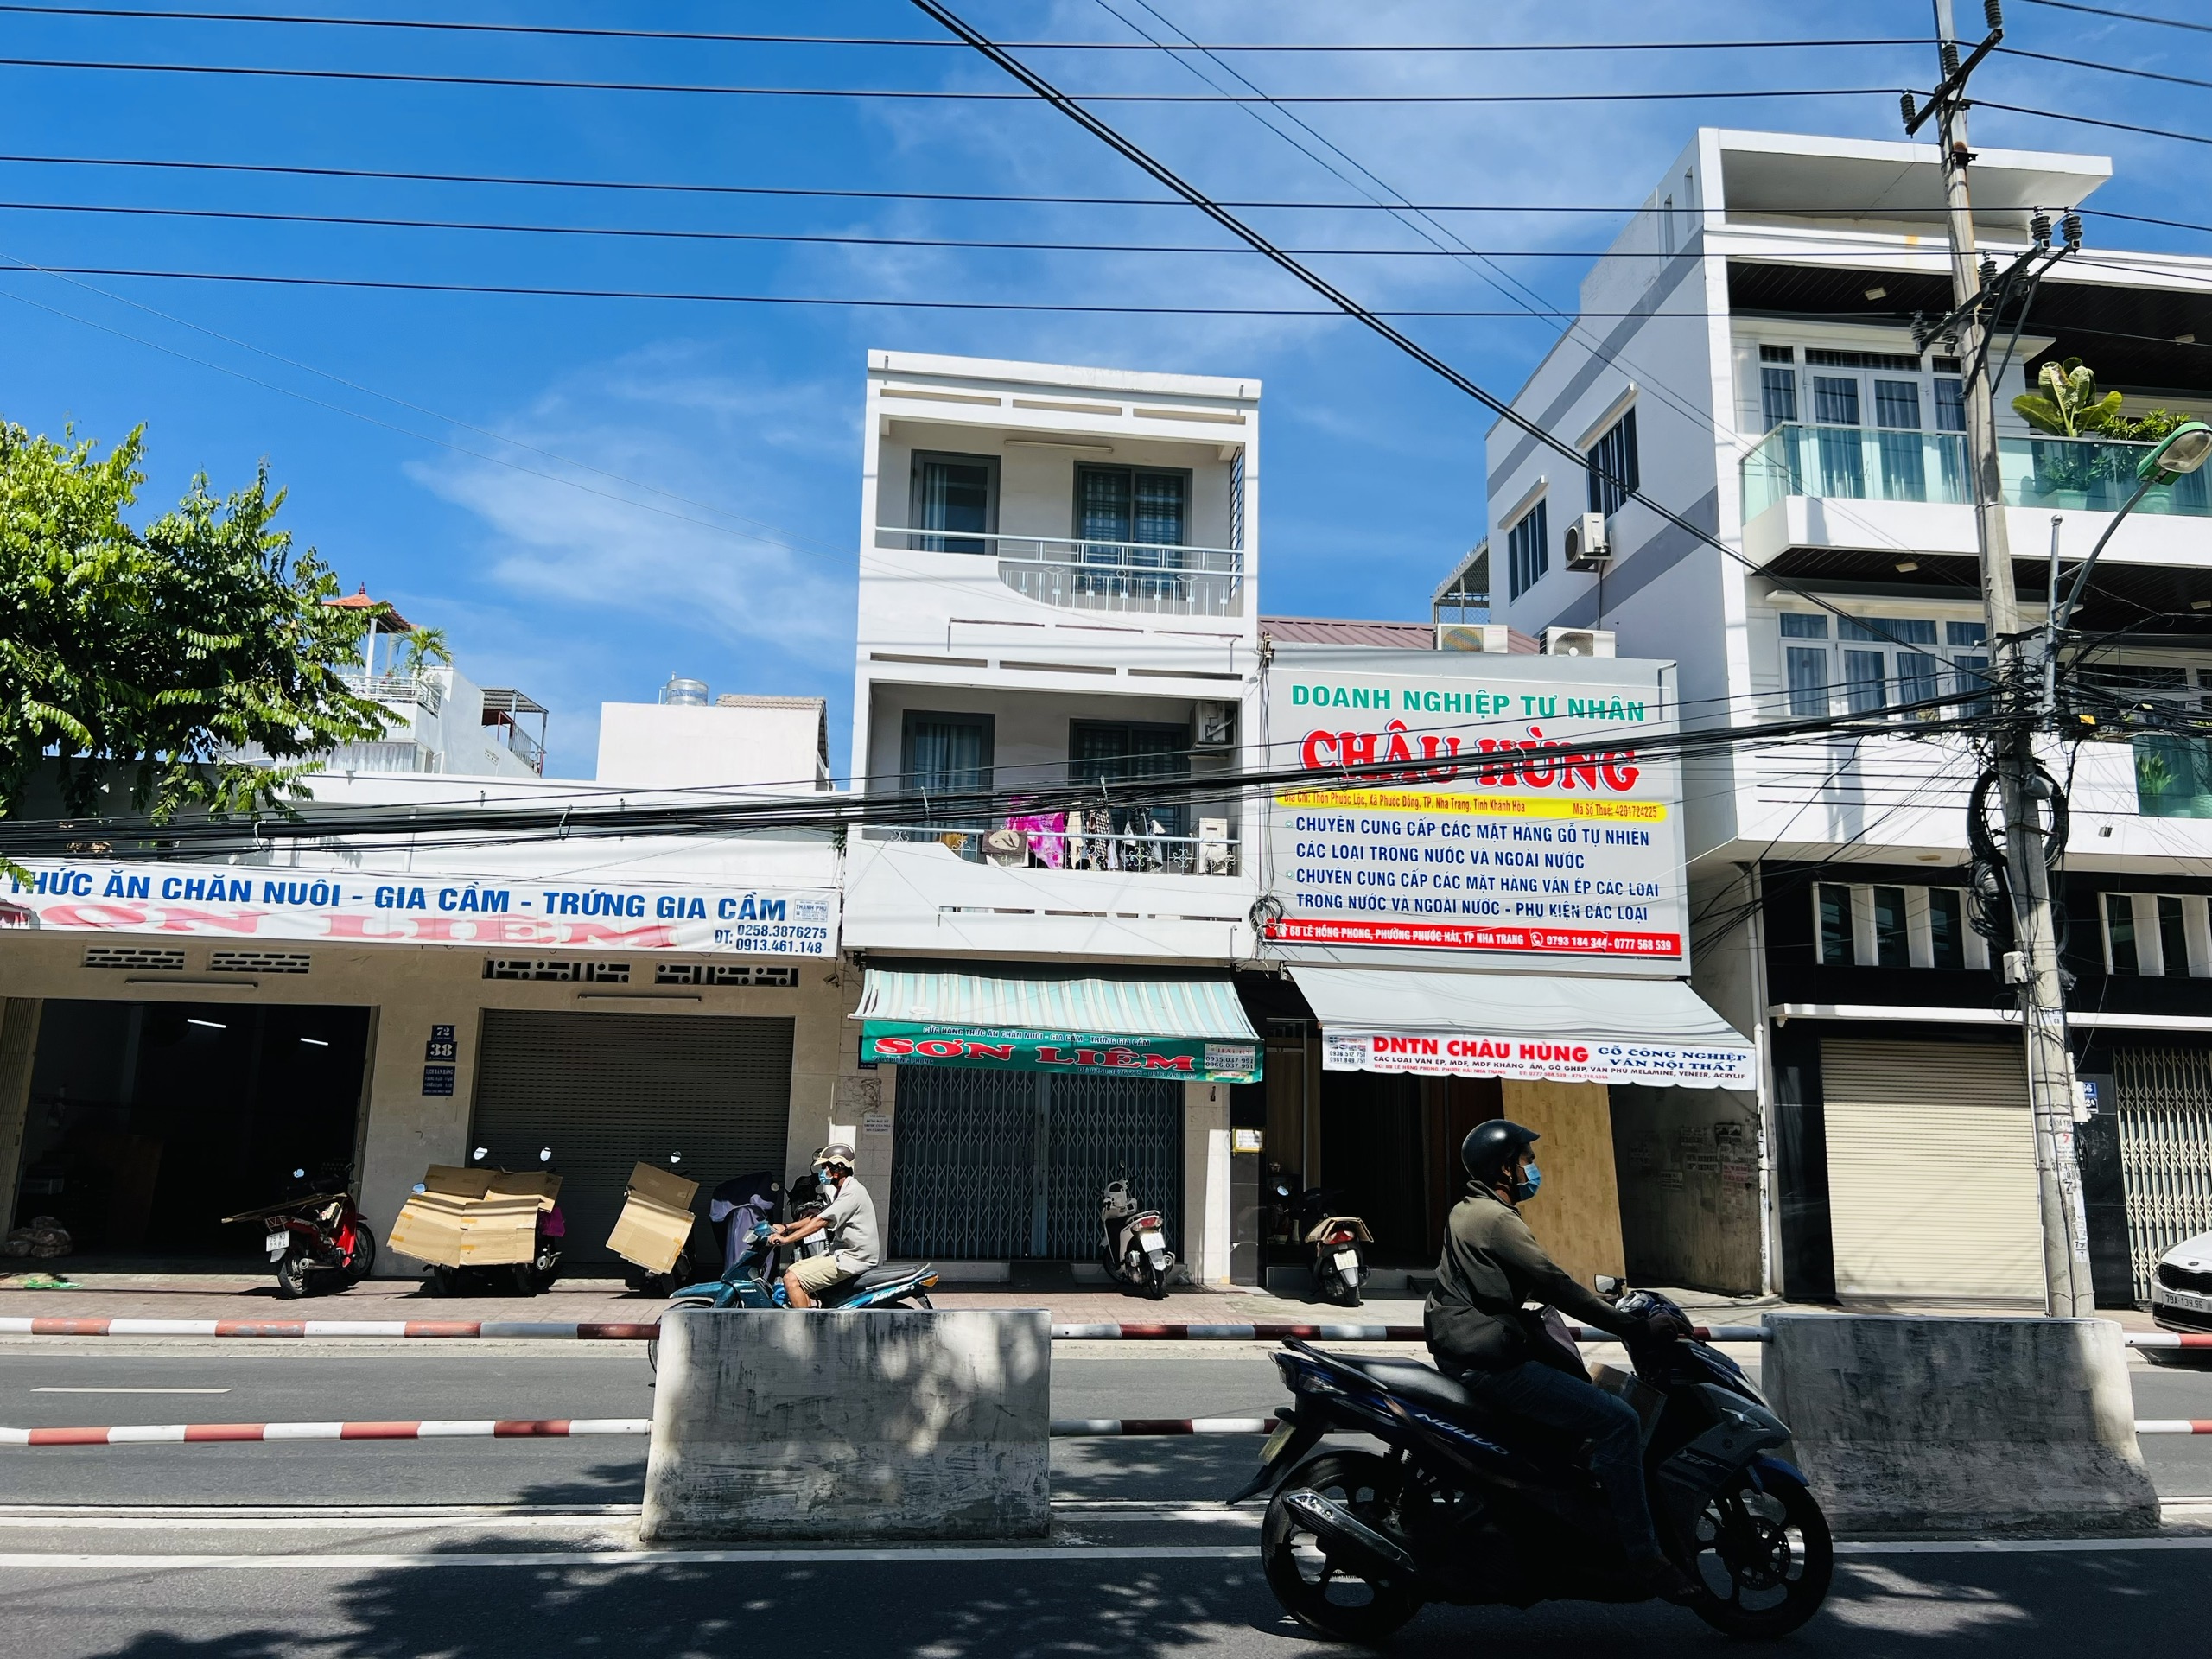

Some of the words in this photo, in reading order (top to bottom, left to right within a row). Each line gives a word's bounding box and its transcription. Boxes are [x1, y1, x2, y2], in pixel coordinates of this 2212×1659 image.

[1292, 684, 1391, 709] DOANH
[1403, 690, 1510, 719] NGHIỆP
[1520, 694, 1558, 717] TƯ
[1567, 696, 1644, 721] NHÂN
[1298, 718, 1461, 784] CHÂU
[1477, 726, 1640, 791] HÙNG
[1297, 815, 1354, 832] CHUYÊN
[1361, 820, 1401, 834] CUNG
[1408, 817, 1435, 836] CẤP
[1442, 820, 1470, 838] CÁC
[1477, 822, 1507, 842] MẶT
[1514, 823, 1552, 842] HÀNG
[1558, 823, 1576, 842] GỖ
[1583, 830, 1599, 847] TỰ
[1606, 827, 1649, 845] NHIÊN
[1297, 840, 1325, 858] CÁC
[1332, 845, 1363, 862] LOẠI
[1371, 847, 1418, 861] TRONG
[1425, 843, 1464, 863] NƯỚC
[1471, 846, 1489, 864] VÀ
[1495, 848, 1538, 866] NGOÀI
[1545, 848, 1584, 868] NƯỚC
[103, 869, 150, 899] ĂN
[162, 874, 252, 902] CHĂN
[263, 879, 340, 906] NUÔI
[374, 886, 427, 910] GIA
[438, 881, 509, 912] CẦM
[543, 889, 645, 918] TRỨNG
[655, 894, 706, 918] GIA
[718, 891, 786, 921] CẦM
[1297, 866, 1351, 884] CHUYÊN
[1358, 871, 1395, 886] CUNG
[1402, 868, 1427, 887] CẤP
[1433, 871, 1460, 888] CÁC
[1467, 872, 1494, 893] MẶT
[1501, 874, 1537, 891] HÀNG
[1543, 875, 1568, 892] VÁN
[1575, 876, 1591, 893] ÉP
[1597, 877, 1622, 893] CÁC
[1630, 883, 1657, 899] LOẠI
[40, 902, 270, 935] ƠN
[1299, 894, 1342, 907] TRONG
[1349, 891, 1386, 910] NƯỚC
[1393, 893, 1408, 910] VÀ
[1415, 894, 1456, 912] NGOÀI
[1463, 894, 1499, 914] NƯỚC
[1516, 903, 1543, 919] PHỤ
[1550, 899, 1580, 921] KIỆN
[1586, 900, 1611, 918] CÁC
[1618, 906, 1647, 923] LOẠI
[715, 929, 733, 944] ĐT:
[738, 925, 827, 939] 0258.3876275
[736, 938, 822, 953] 0913.461.148
[1289, 926, 1300, 937] 68
[1303, 925, 1313, 937] LÊ
[1315, 924, 1338, 938] HỒNG
[1341, 928, 1373, 940] PHONG,
[1376, 927, 1410, 940] PHƯỜNG
[1413, 929, 1441, 941] PHƯỚC
[1445, 930, 1461, 944] HẢI,
[1464, 932, 1474, 943] TP
[1477, 934, 1494, 944] NHA
[1496, 934, 1524, 944] TRANG
[1547, 936, 1569, 945] 0793
[1571, 937, 1588, 946] 184
[1614, 938, 1635, 949] 0777
[1637, 939, 1653, 950] 568
[1655, 940, 1672, 950] 539
[436, 1027, 450, 1036] 72
[430, 1043, 453, 1056] 38
[874, 1038, 1016, 1060] SƠN
[1035, 1046, 1195, 1071] LIÊM
[1373, 1036, 1438, 1055] DNTN
[1447, 1039, 1510, 1059] CHÂU
[1519, 1041, 1589, 1063] HÙNG
[1599, 1045, 1622, 1055] GỖ
[1628, 1047, 1675, 1058] CÔNG
[1682, 1051, 1746, 1062] NGHIỆP
[1610, 1058, 1646, 1067] VÁN
[1654, 1060, 1683, 1070] NỘI
[1689, 1062, 1735, 1071] THẤT
[1414, 1413, 1509, 1455] NOUVO
